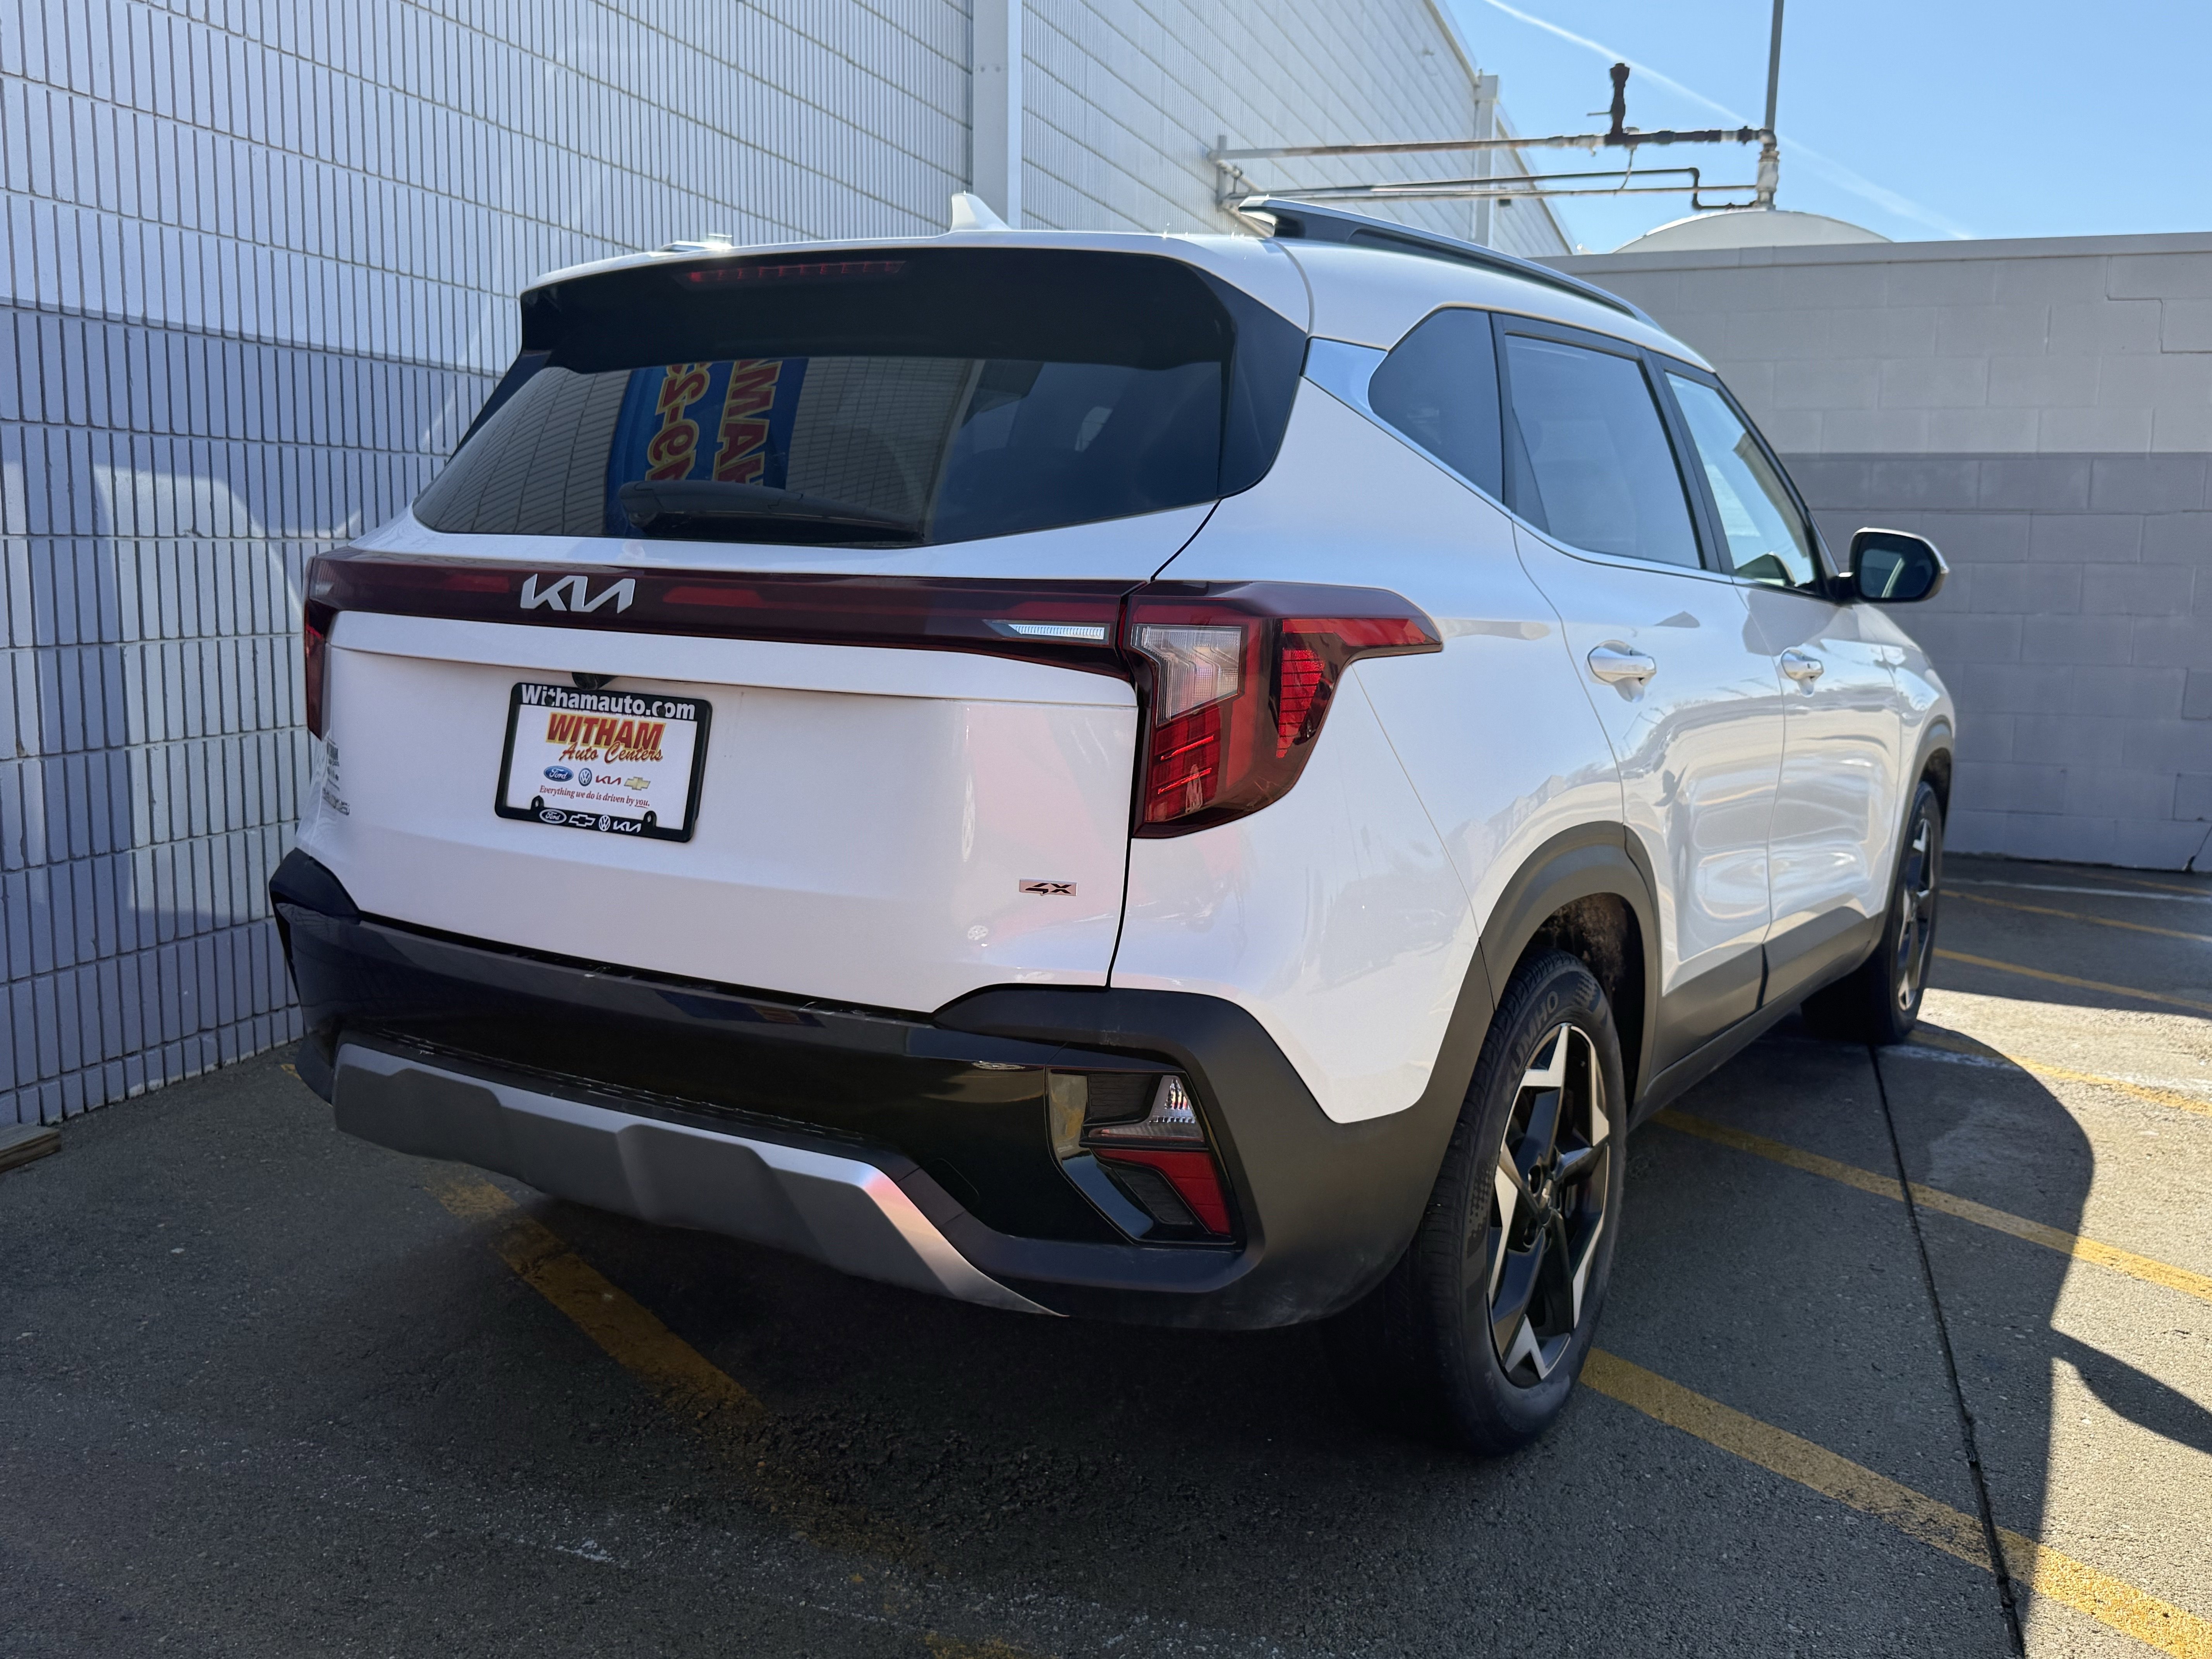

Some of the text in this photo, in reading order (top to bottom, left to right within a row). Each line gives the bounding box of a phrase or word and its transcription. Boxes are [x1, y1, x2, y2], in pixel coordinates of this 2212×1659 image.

[520, 573, 635, 613] KIA
[522, 684, 696, 720] Withamauto.com
[546, 712, 666, 750] WITHAM
[559, 740, 663, 764] Auto Centers
[596, 775, 622, 785] KIA
[539, 785, 575, 799] Everything
[586, 791, 595, 800] do
[603, 794, 625, 803] driven
[626, 795, 634, 806] by
[635, 799, 650, 807] you.
[613, 821, 642, 833] KIA
